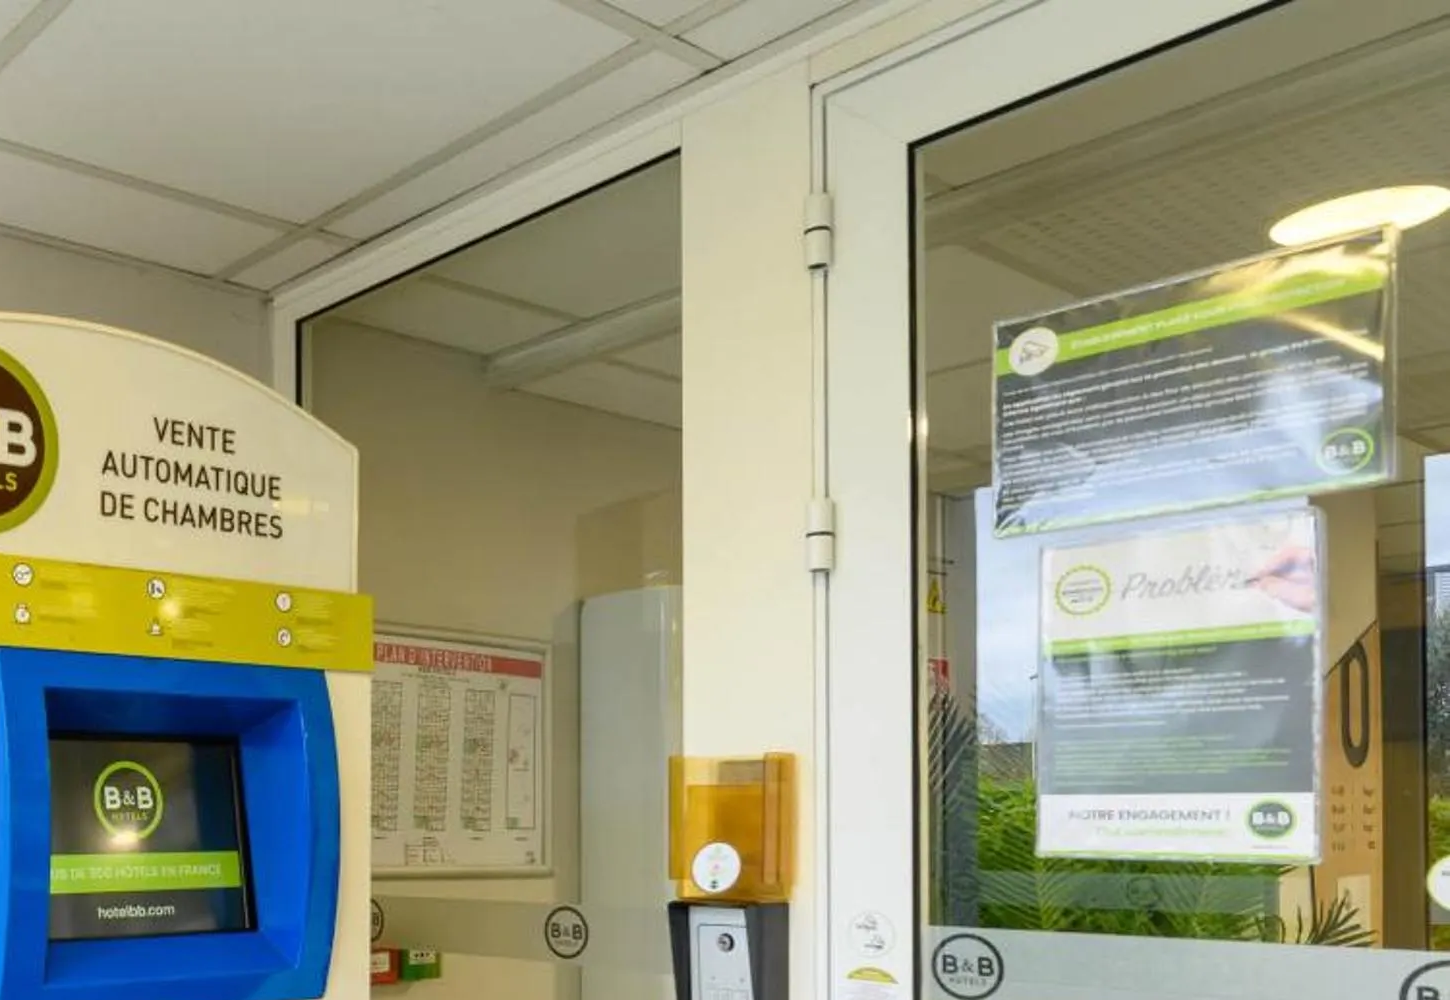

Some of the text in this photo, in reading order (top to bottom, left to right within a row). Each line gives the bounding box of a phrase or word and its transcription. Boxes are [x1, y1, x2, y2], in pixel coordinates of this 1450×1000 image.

[154, 416, 236, 455] VENTE
[101, 450, 282, 501] AUTOMATIQUE
[100, 491, 284, 540] DE CHAMBRES
[377, 643, 406, 663] PLAN
[104, 786, 154, 810] B&B
[1119, 808, 1220, 822] ENGAGEMENT
[97, 903, 175, 921] hotelbb.com
[942, 954, 994, 977] B&B
